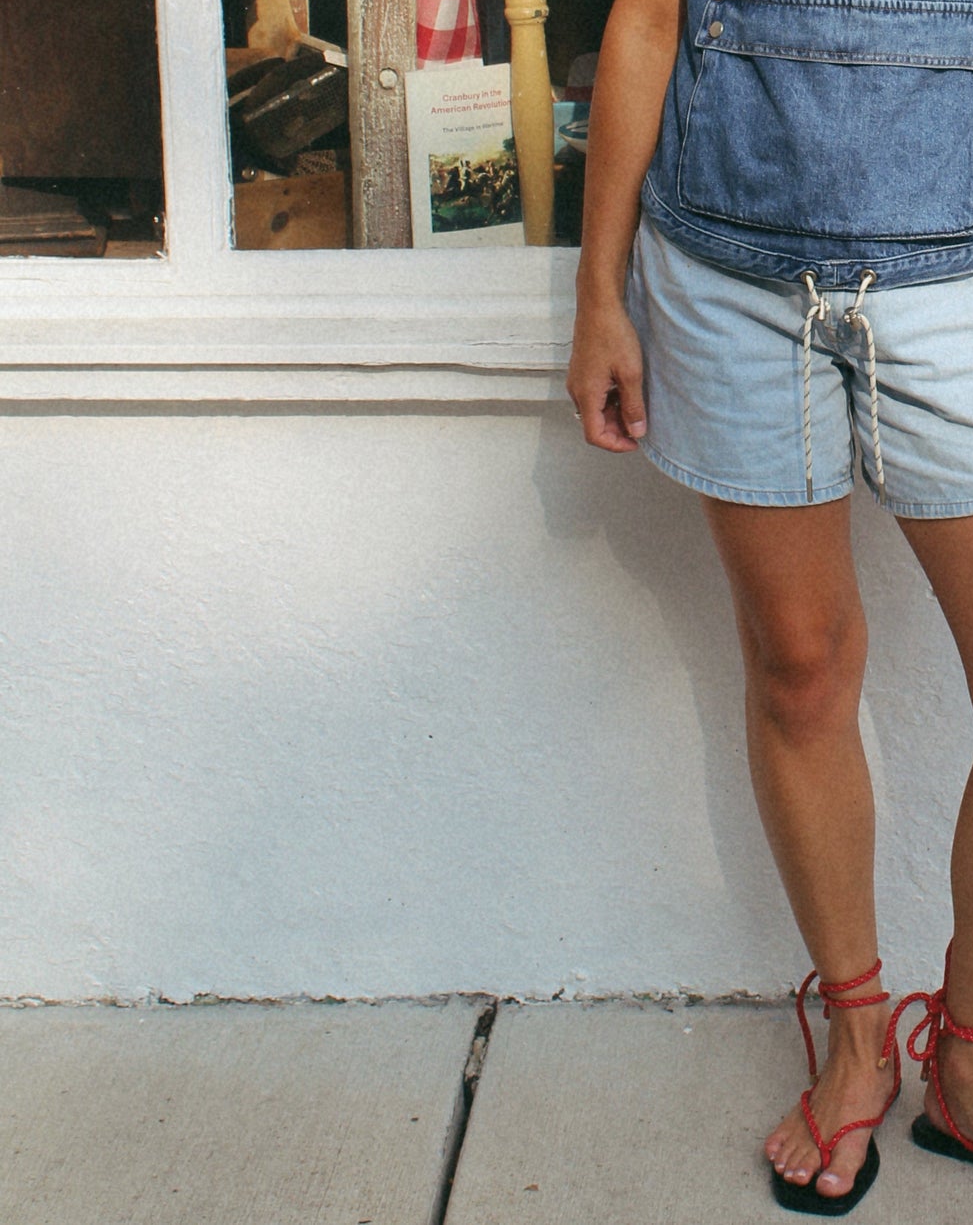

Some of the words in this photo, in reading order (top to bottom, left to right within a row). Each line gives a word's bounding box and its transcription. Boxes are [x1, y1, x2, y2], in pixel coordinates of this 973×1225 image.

[442, 92, 480, 102] Cranbury
[490, 87, 502, 96] the
[431, 103, 472, 114] American
[473, 99, 512, 111] Revolution
